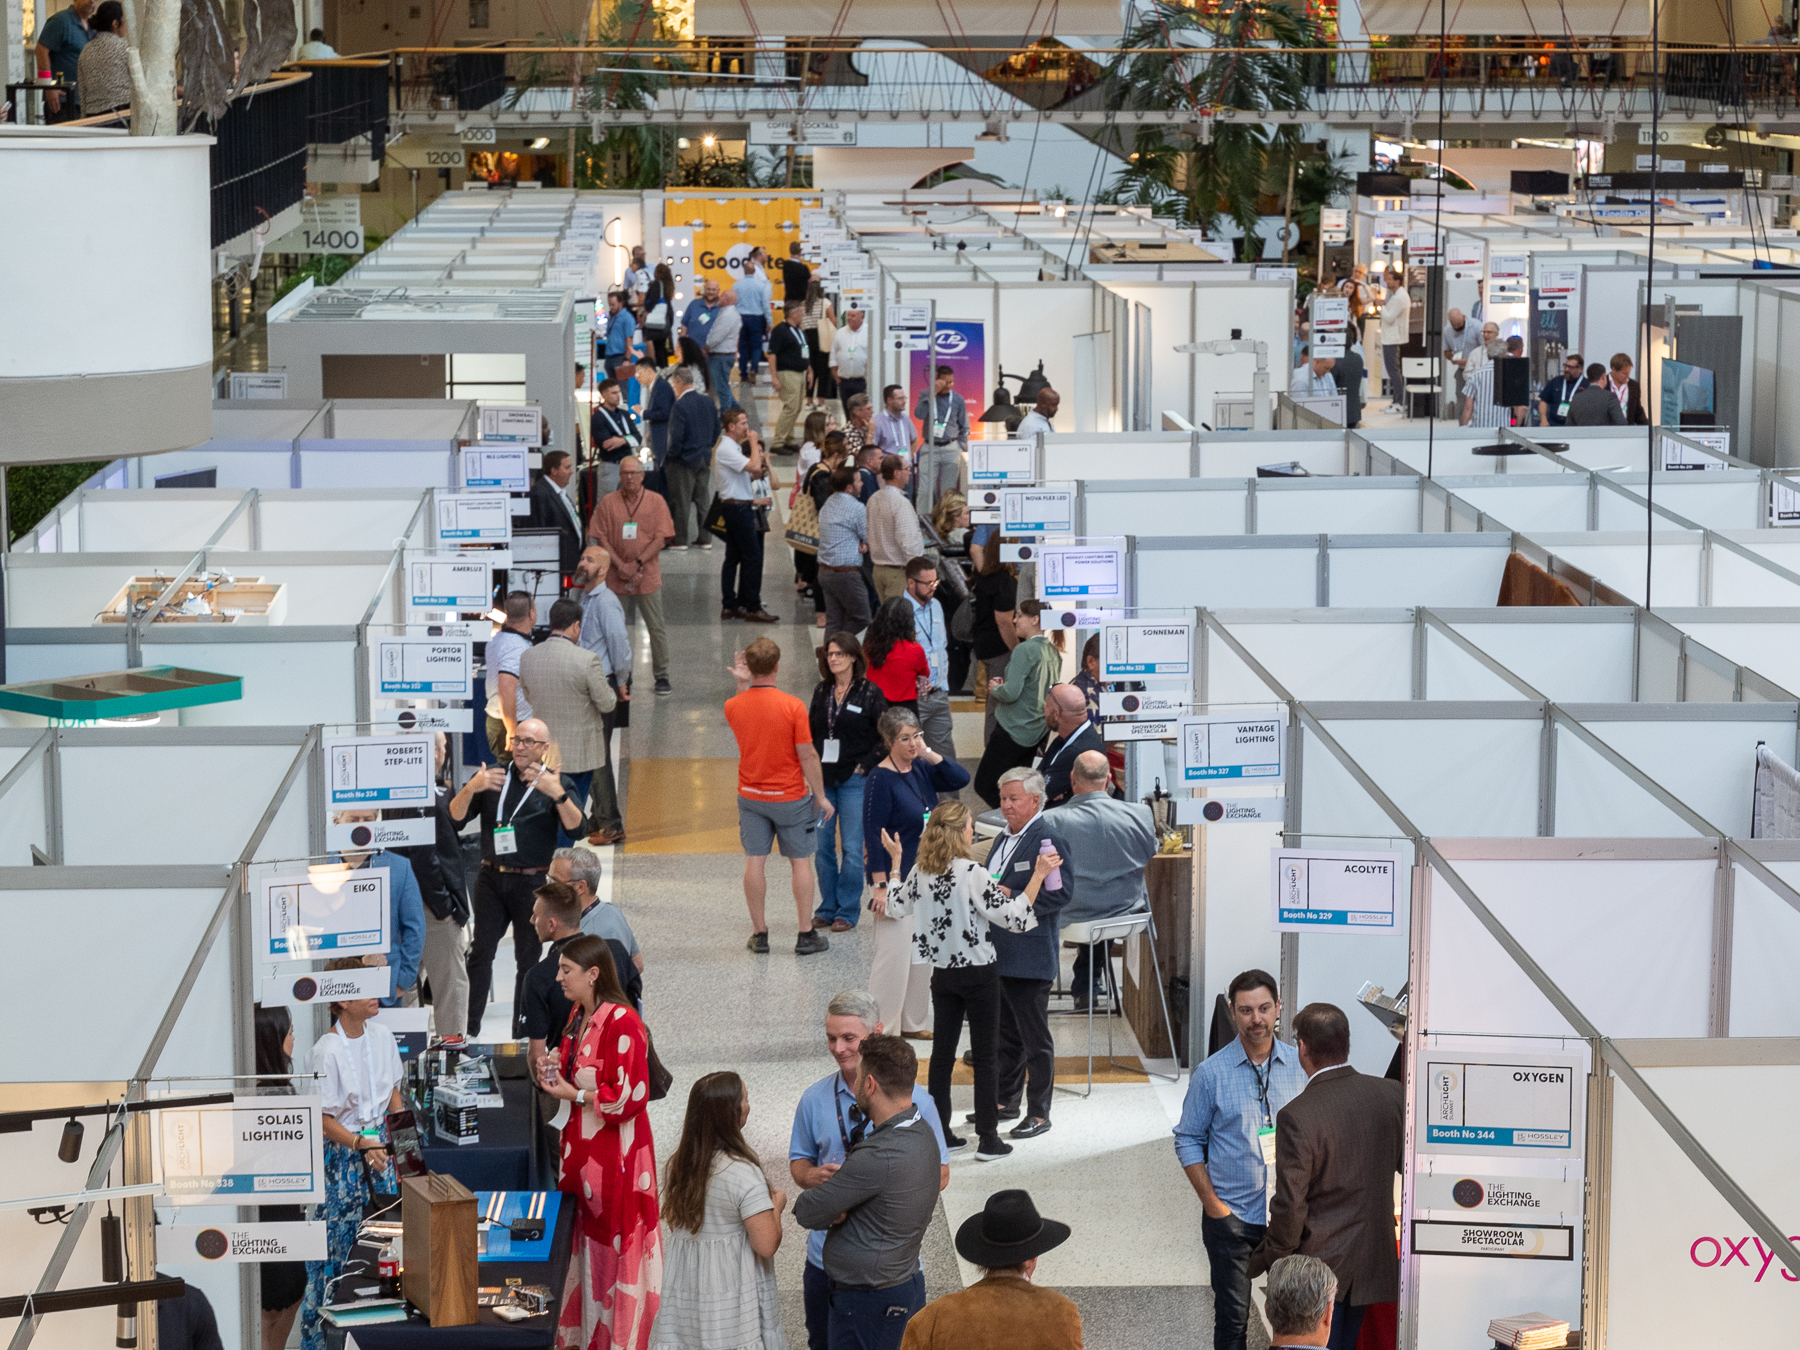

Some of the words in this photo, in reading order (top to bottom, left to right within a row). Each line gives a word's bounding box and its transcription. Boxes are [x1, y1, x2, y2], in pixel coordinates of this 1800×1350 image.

[461, 128, 493, 141] 1000
[426, 152, 462, 165] 1200
[302, 230, 359, 249] 1400
[384, 682, 401, 690] Booth
[1237, 724, 1276, 733] VANTAGE
[1235, 735, 1276, 744] LIGHTING
[386, 747, 424, 755] ROBERTS
[384, 757, 424, 766] STEP-LITE
[1188, 768, 1207, 776] Booth
[335, 791, 355, 799] Booth
[374, 835, 410, 843] EXCHANGE
[1344, 865, 1388, 874] ACOLYTE
[353, 883, 376, 893] EIKO
[1283, 911, 1305, 919] Booth
[1306, 912, 1318, 920] No
[1318, 912, 1333, 920] 329
[319, 982, 355, 991] LIGHTING
[319, 987, 361, 997] EXCHANGE
[1513, 1071, 1565, 1084] OXYGEN
[257, 1114, 304, 1126] SOLAIS
[242, 1130, 305, 1142] LIGHTING
[1432, 1128, 1460, 1139] Booth
[1461, 1129, 1476, 1140] No
[1477, 1130, 1496, 1140] 344
[169, 1178, 199, 1189] Booth
[200, 1178, 215, 1188] No
[215, 1178, 234, 1188] 338
[268, 1177, 307, 1185] HOSSLEY
[1487, 1183, 1506, 1191] THE
[1487, 1190, 1533, 1200] LIGHTING
[1487, 1198, 1541, 1208] EXCHANGE
[231, 1231, 251, 1241] THE
[1463, 1229, 1524, 1239] SHOWROOM
[231, 1238, 279, 1248] LIGHTING
[1461, 1236, 1525, 1247] SPECTACULAR
[231, 1246, 288, 1256] EXCHANGE
